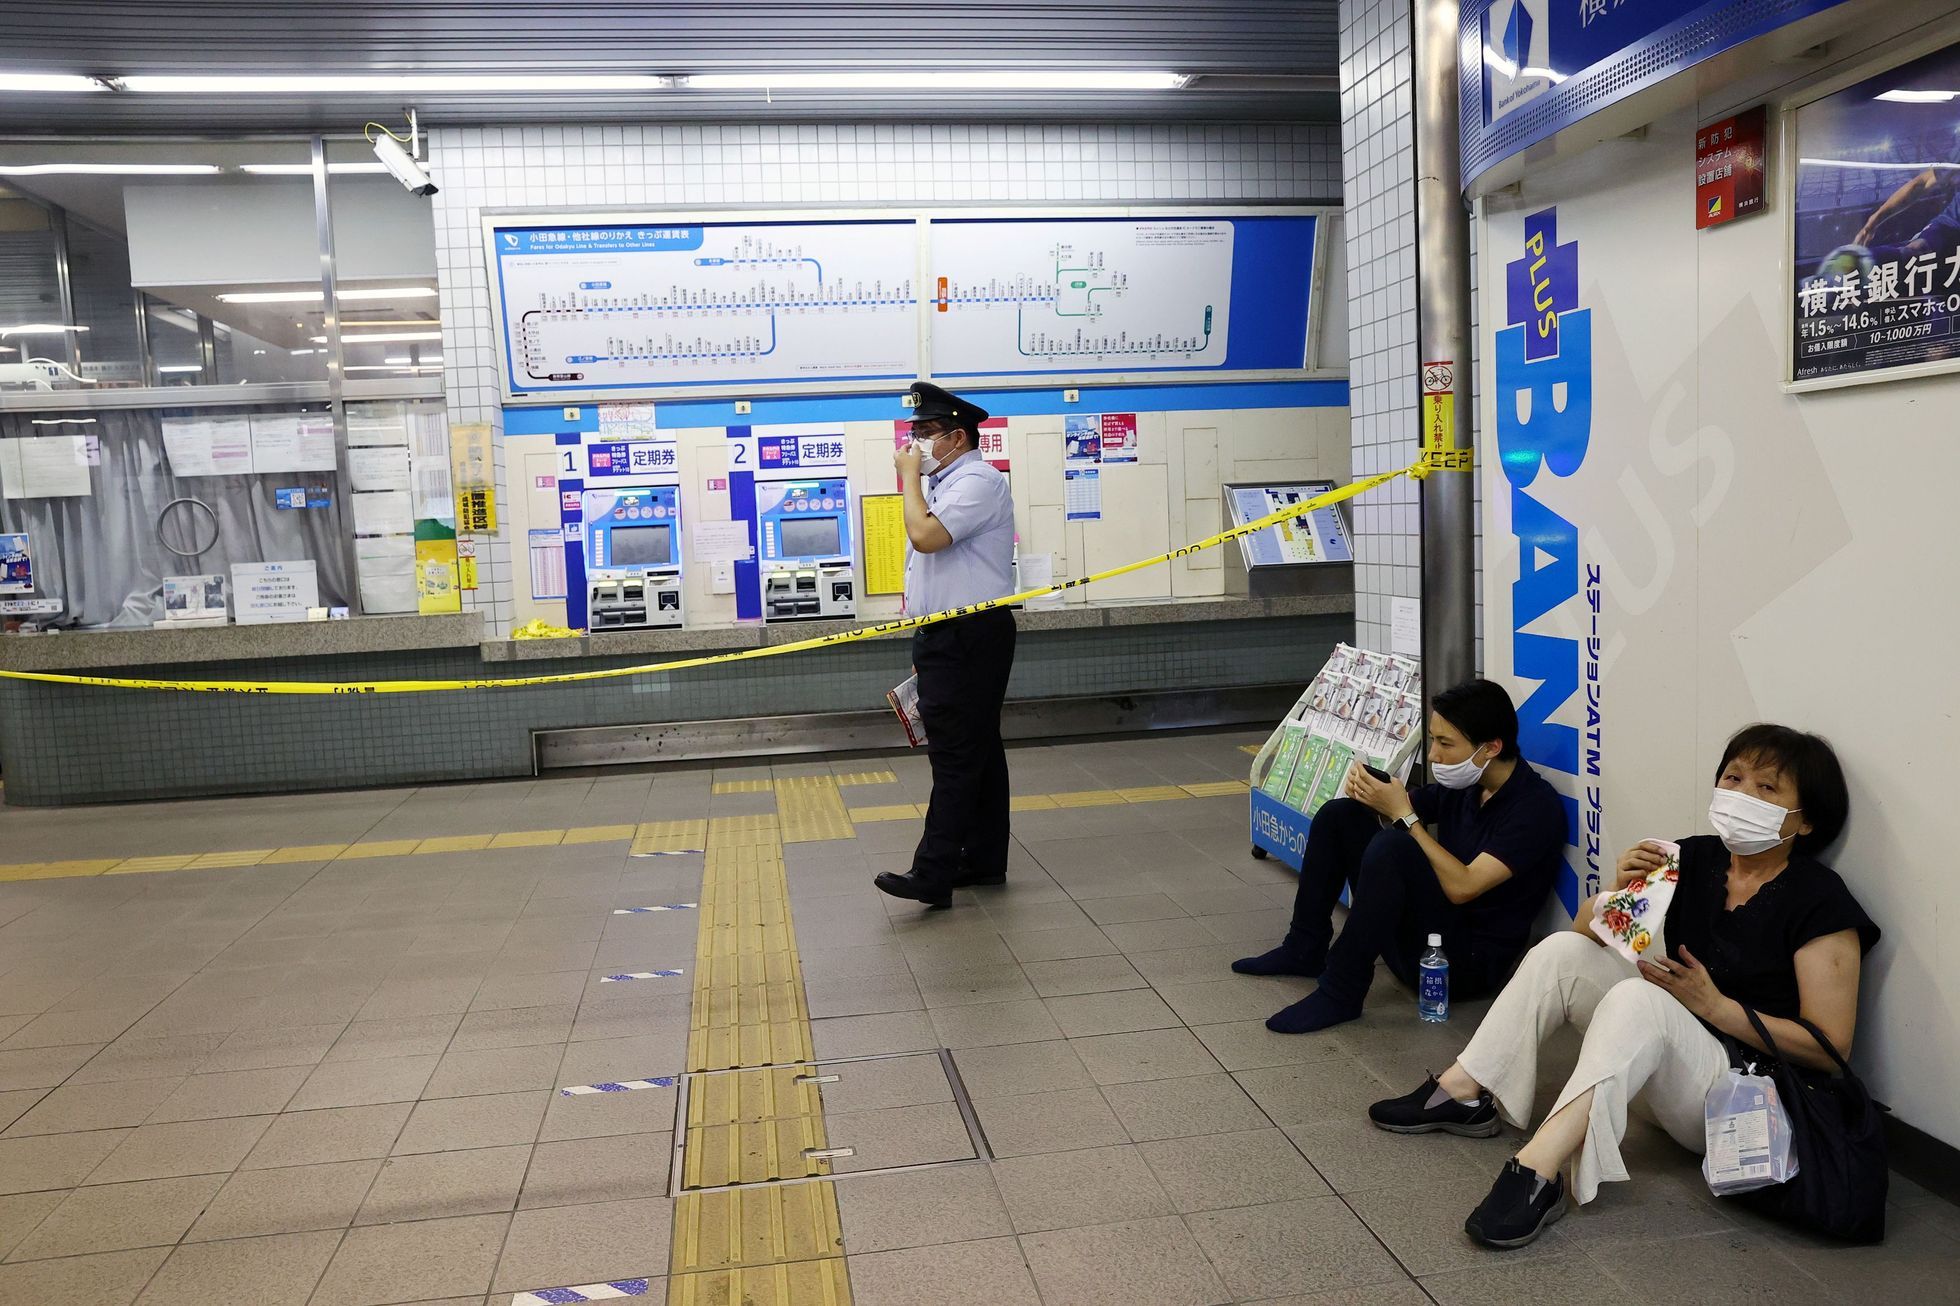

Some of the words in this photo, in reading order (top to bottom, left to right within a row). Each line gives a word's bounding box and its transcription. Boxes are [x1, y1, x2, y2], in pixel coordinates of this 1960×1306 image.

[1515, 79, 1541, 99] Yokohama
[1698, 126, 1732, 149] 新防犯
[1698, 146, 1732, 168] システム
[1698, 163, 1732, 187] 設置店舗
[1525, 231, 1557, 340] PLUS
[1807, 338, 1848, 353] お借入限度額
[1797, 366, 1818, 377] Afresh
[633, 449, 675, 466] 定期券
[734, 443, 747, 464] 2
[802, 442, 844, 459] 定期券
[1420, 451, 1469, 469] KEEP
[563, 451, 577, 472] 1
[1586, 563, 1600, 777] ステーションATM
[1253, 805, 1308, 858] 小田急からの
[1426, 976, 1443, 985] 箱根
